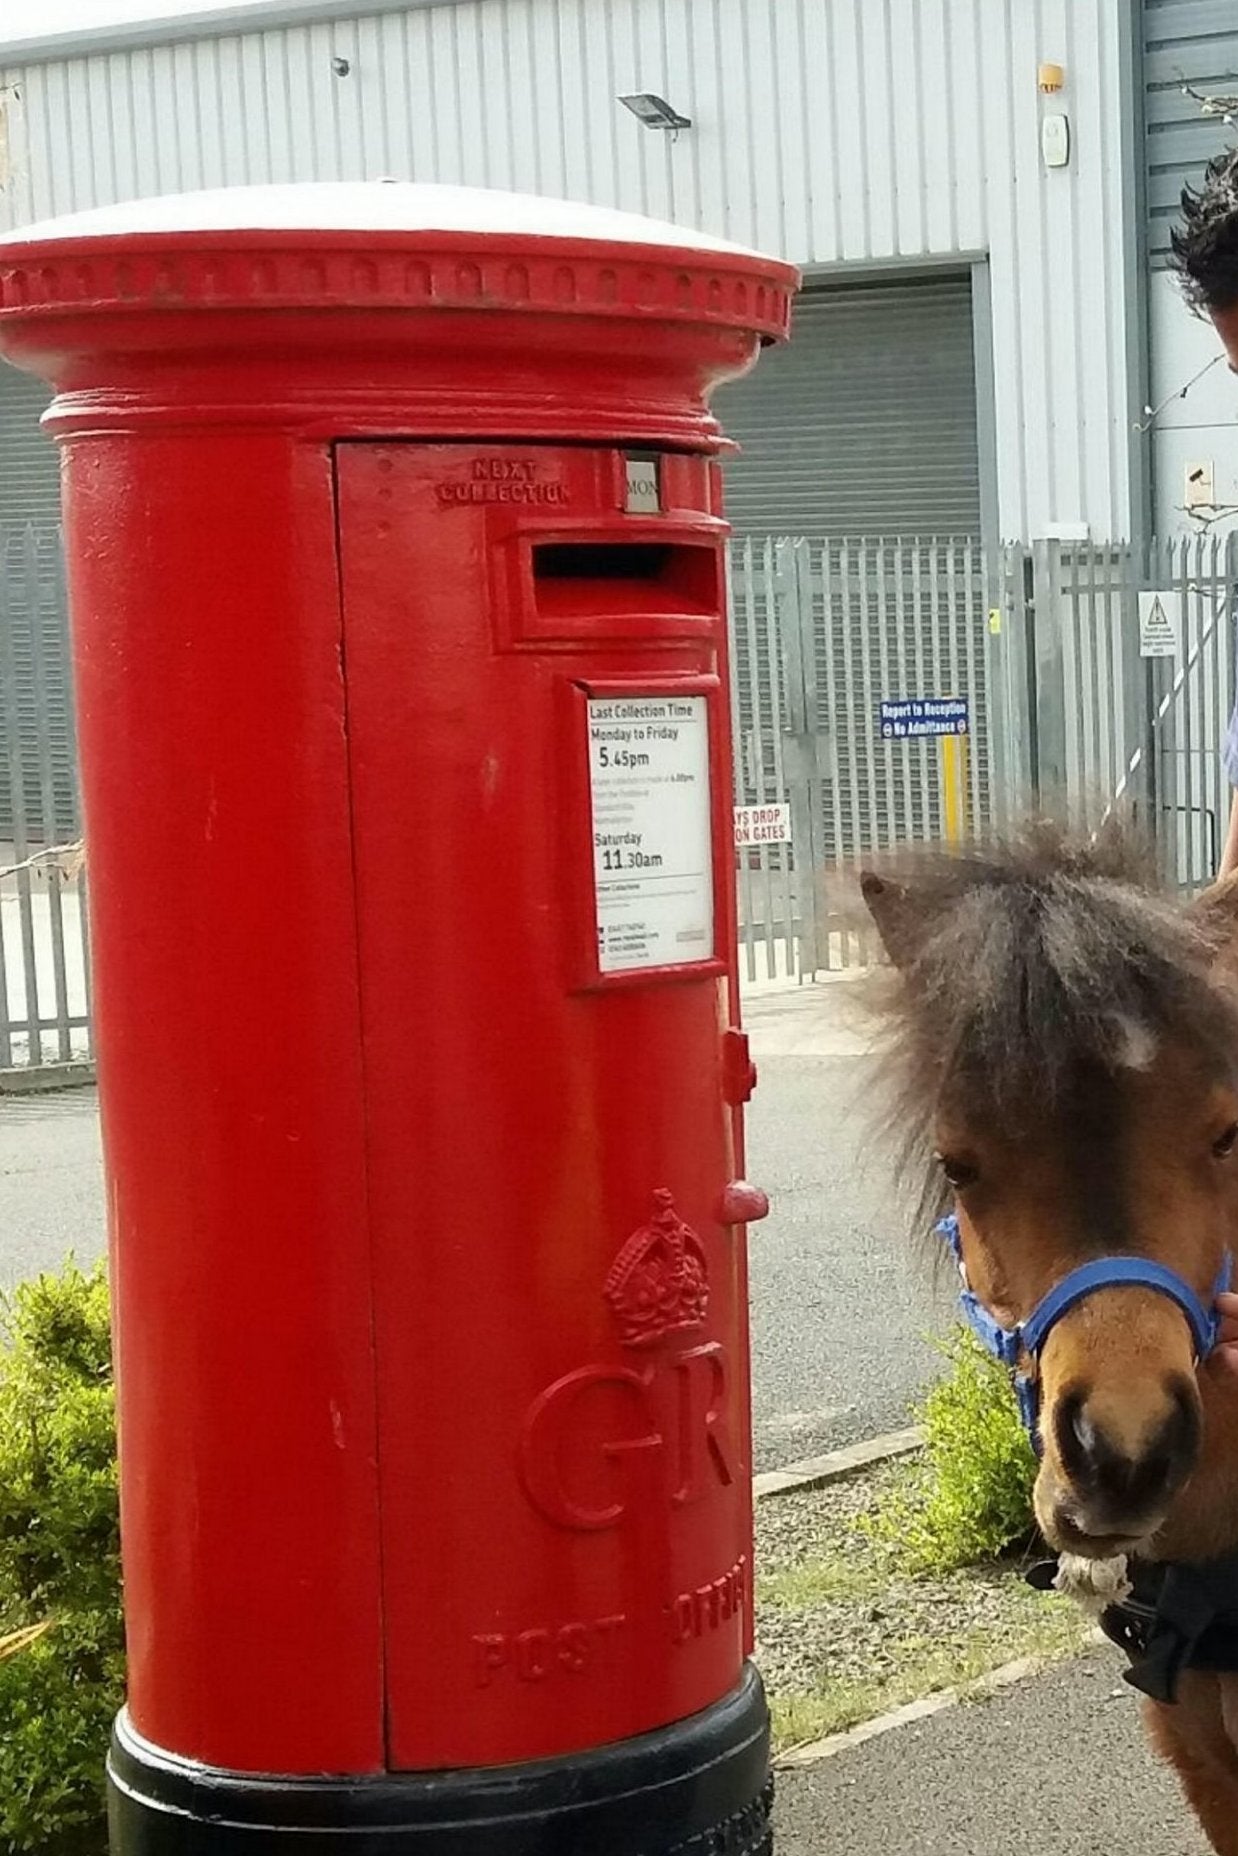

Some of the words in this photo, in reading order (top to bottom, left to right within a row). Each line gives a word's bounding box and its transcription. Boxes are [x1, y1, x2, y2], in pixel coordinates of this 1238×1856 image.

[473, 458, 536, 481] NEXT
[437, 482, 572, 506] COLLECTION
[627, 480, 659, 496] MON
[590, 705, 612, 719] Last
[615, 703, 666, 718] Collection
[667, 702, 693, 717] Time
[882, 703, 911, 720] Report
[912, 702, 923, 717] to
[924, 701, 966, 718] Reception
[591, 727, 632, 742] Monday
[634, 729, 645, 740] to
[646, 725, 679, 741] Friday
[894, 722, 906, 736] No
[908, 720, 956, 735] Admittance
[599, 746, 650, 769] 5.45pm
[752, 808, 781, 825] DROP
[595, 832, 642, 847] Saturday
[735, 827, 750, 842] ON
[753, 825, 786, 841] GATES
[603, 849, 663, 870] 11.30am
